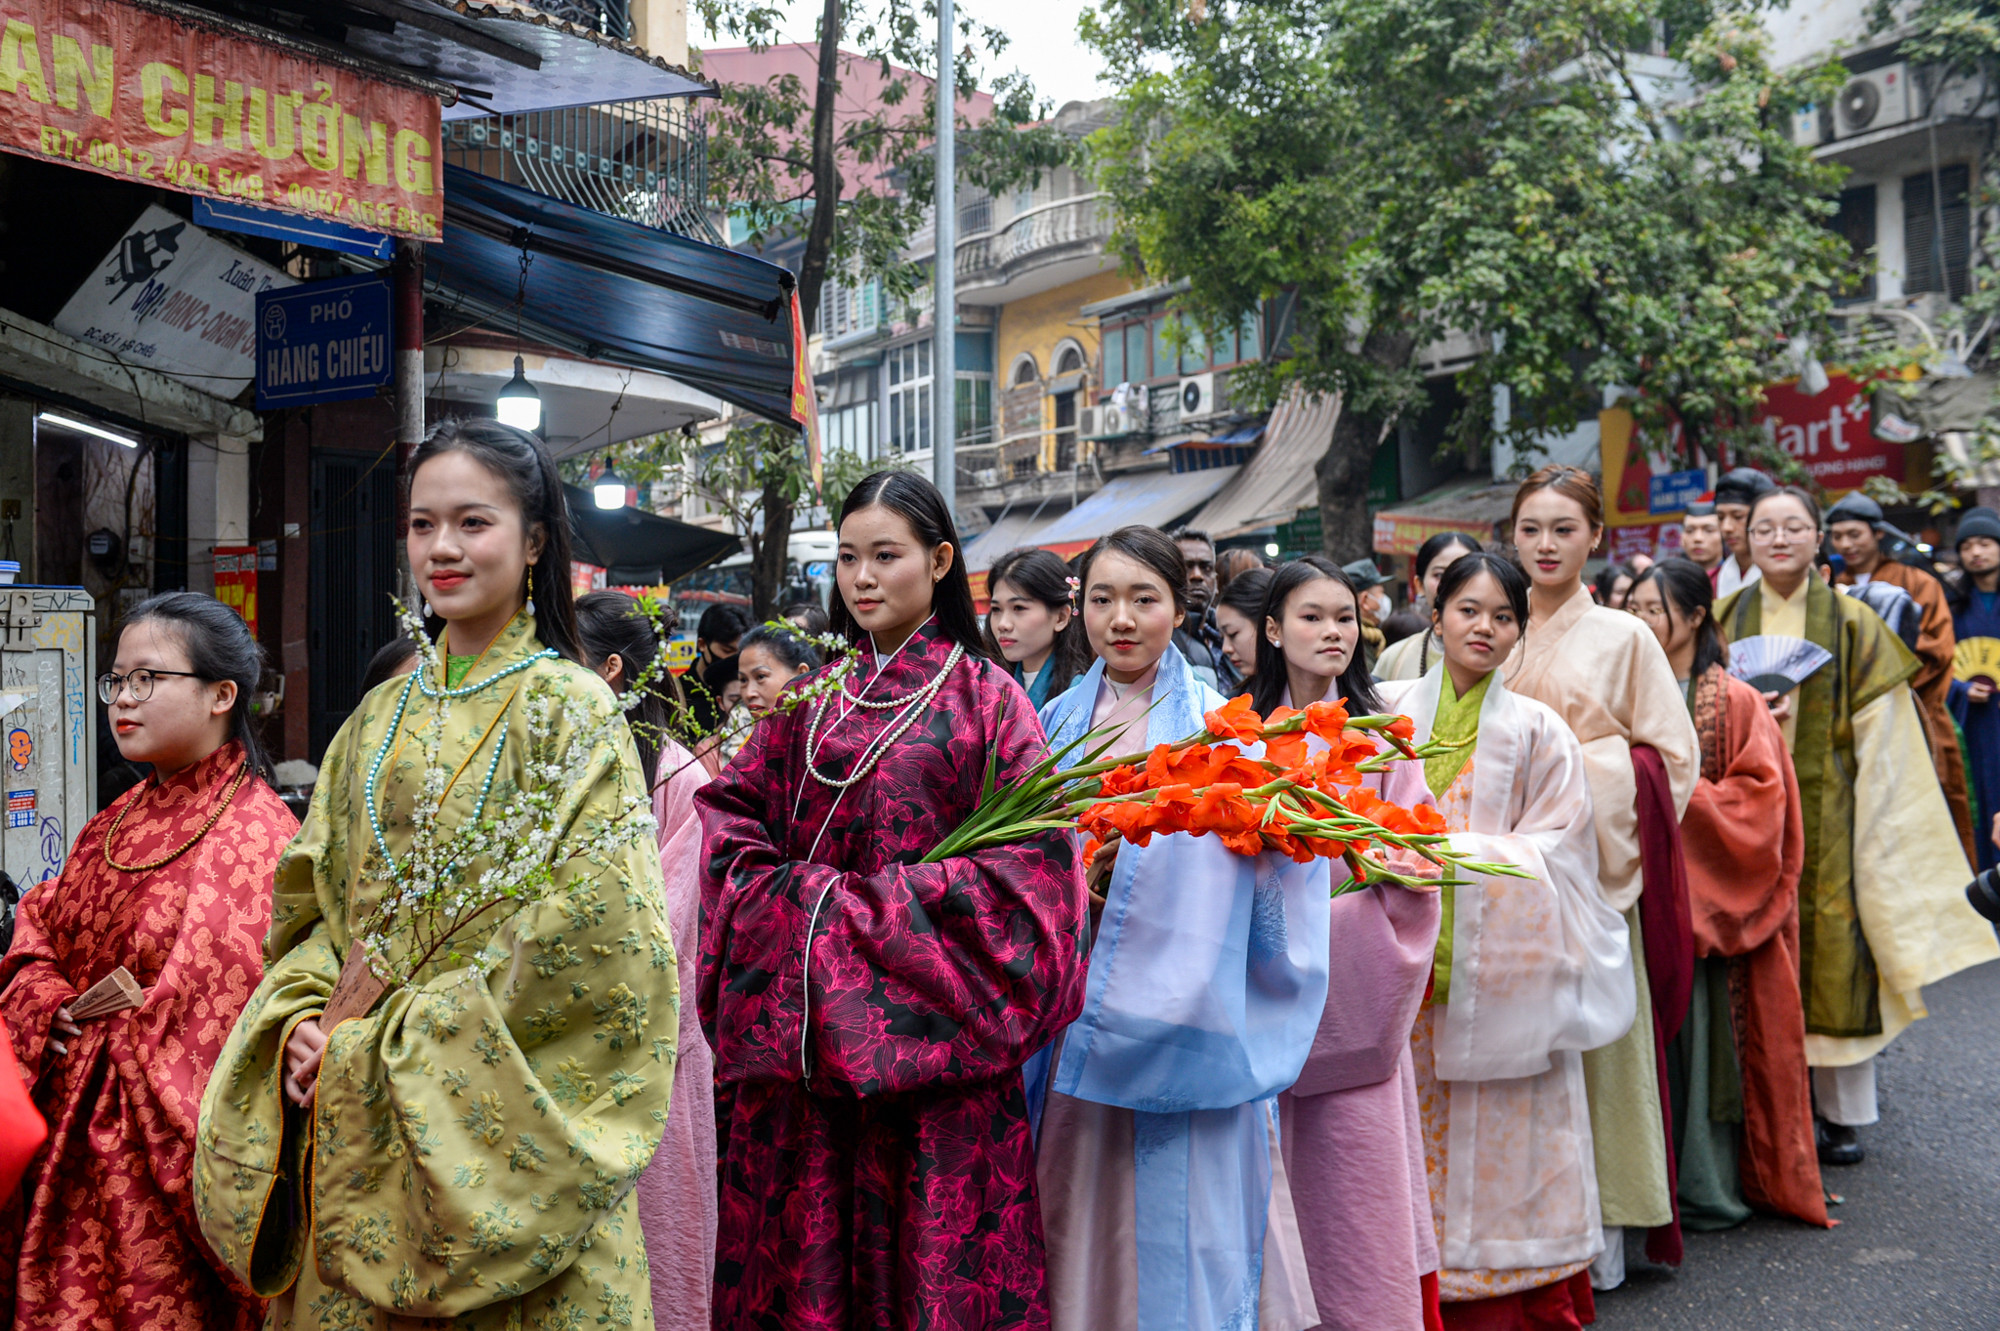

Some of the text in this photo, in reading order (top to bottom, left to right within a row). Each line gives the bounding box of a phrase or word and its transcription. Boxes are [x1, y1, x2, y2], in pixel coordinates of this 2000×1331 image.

[0, 18, 114, 120] AN
[40, 125, 83, 162] ĐT:
[89, 138, 155, 180] 0912
[163, 156, 209, 190] 429
[218, 167, 265, 201] 548
[288, 182, 343, 217] 0947
[348, 198, 391, 227] 363
[397, 206, 437, 236] 858
[310, 289, 354, 324] PHỐ
[267, 322, 384, 387] HÀNG CHIẾU
